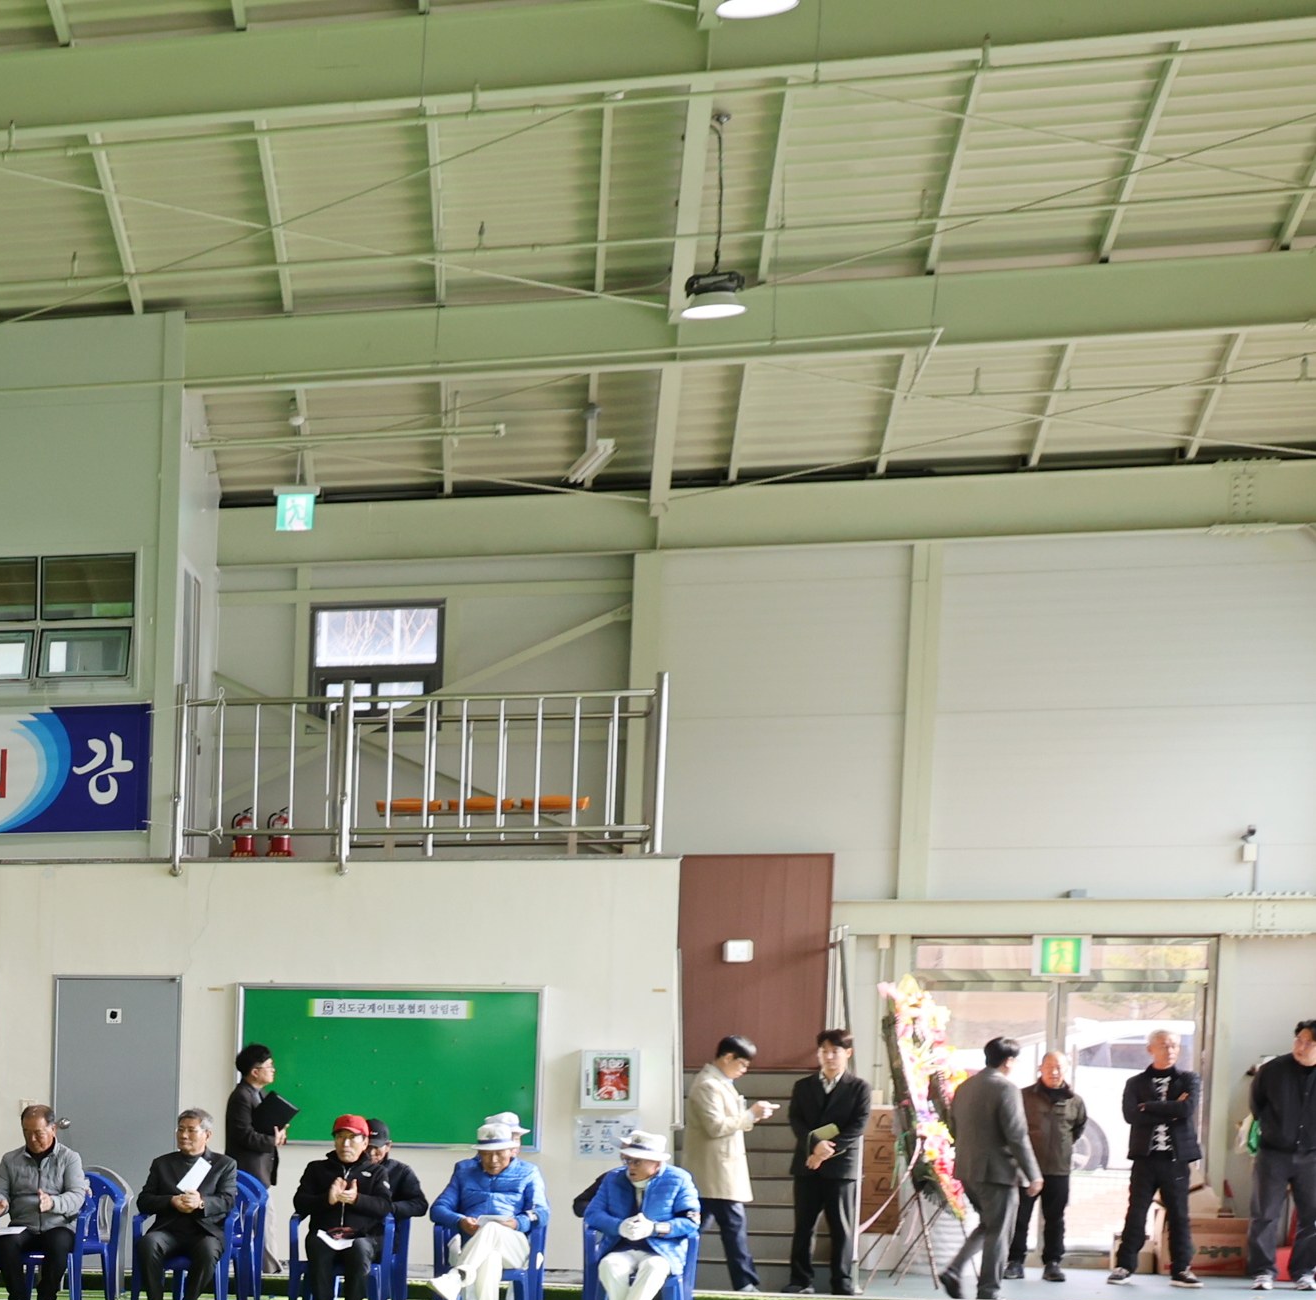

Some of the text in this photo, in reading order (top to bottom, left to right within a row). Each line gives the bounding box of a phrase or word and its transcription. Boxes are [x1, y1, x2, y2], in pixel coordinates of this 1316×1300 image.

[72, 732, 133, 805] 강
[337, 1002, 460, 1016] 진도군게이트볼협회 알림판
